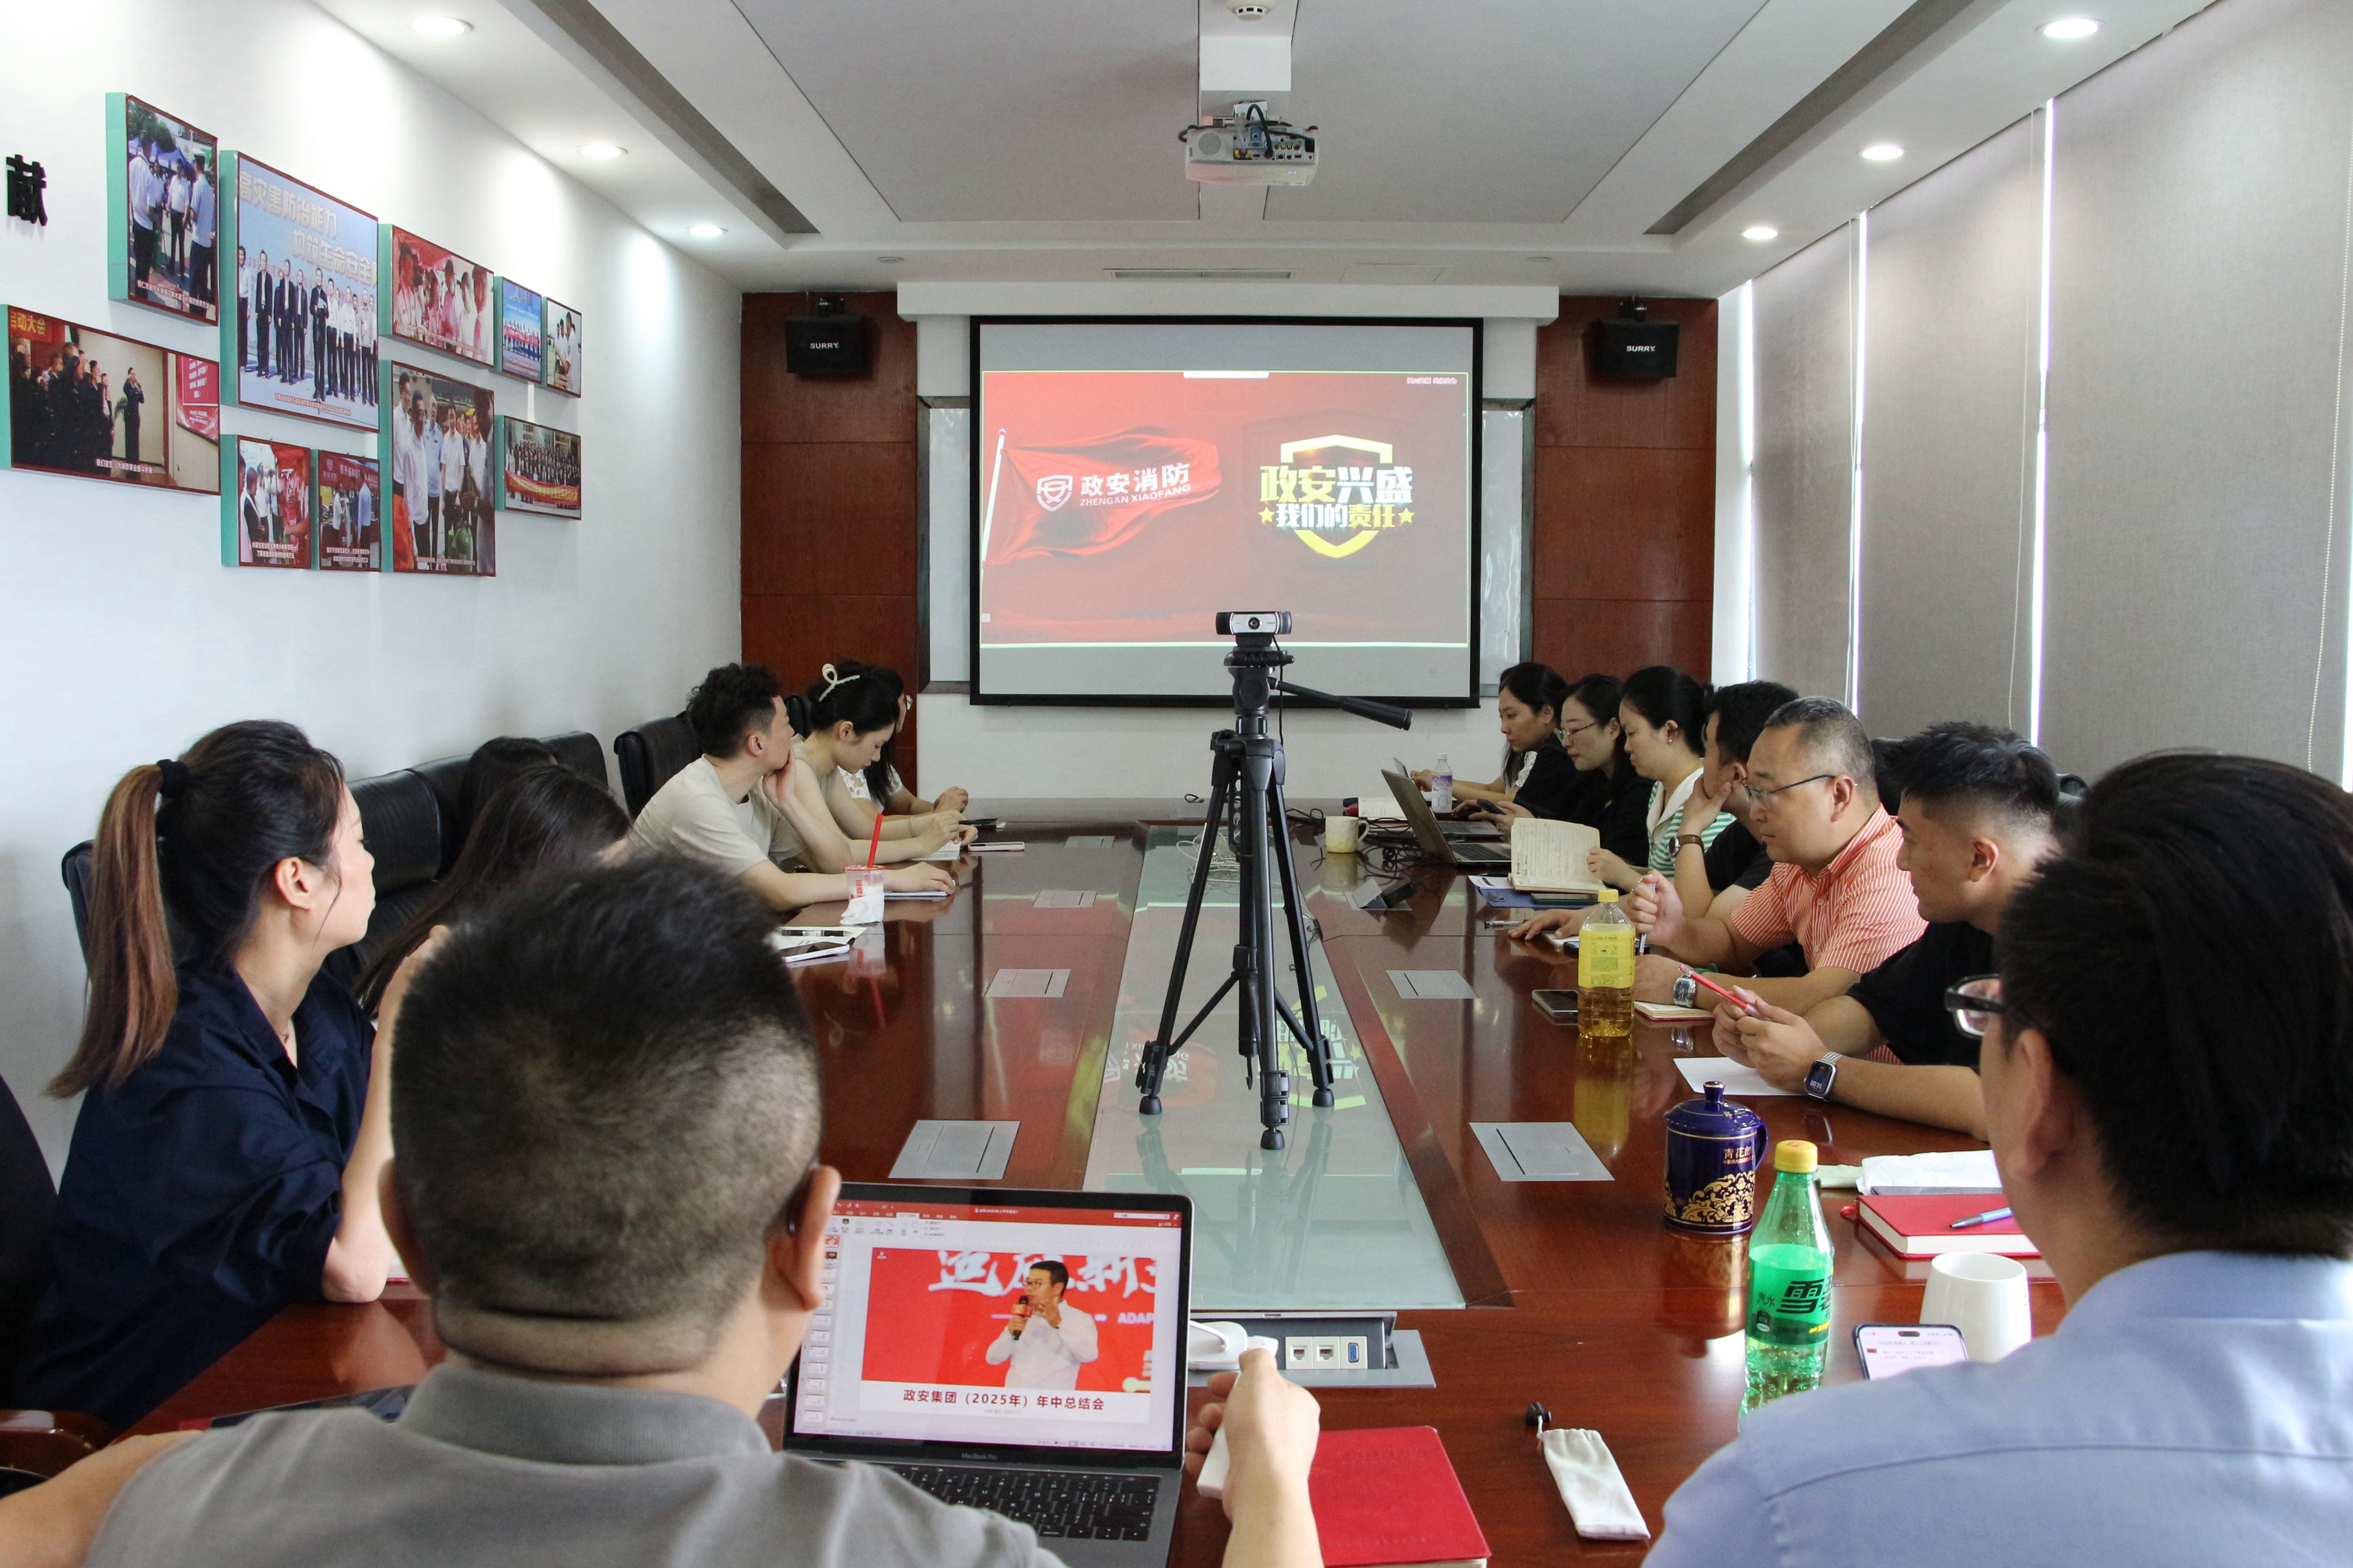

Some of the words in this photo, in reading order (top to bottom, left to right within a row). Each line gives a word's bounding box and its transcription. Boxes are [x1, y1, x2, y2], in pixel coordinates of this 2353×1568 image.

[1081, 462, 1190, 497] 政安消防
[1260, 465, 1413, 503] 政安兴盛
[1080, 496, 1129, 507] ZHENGAN
[1131, 484, 1192, 503] XIAOFANG
[1276, 503, 1395, 528] 我们的责任
